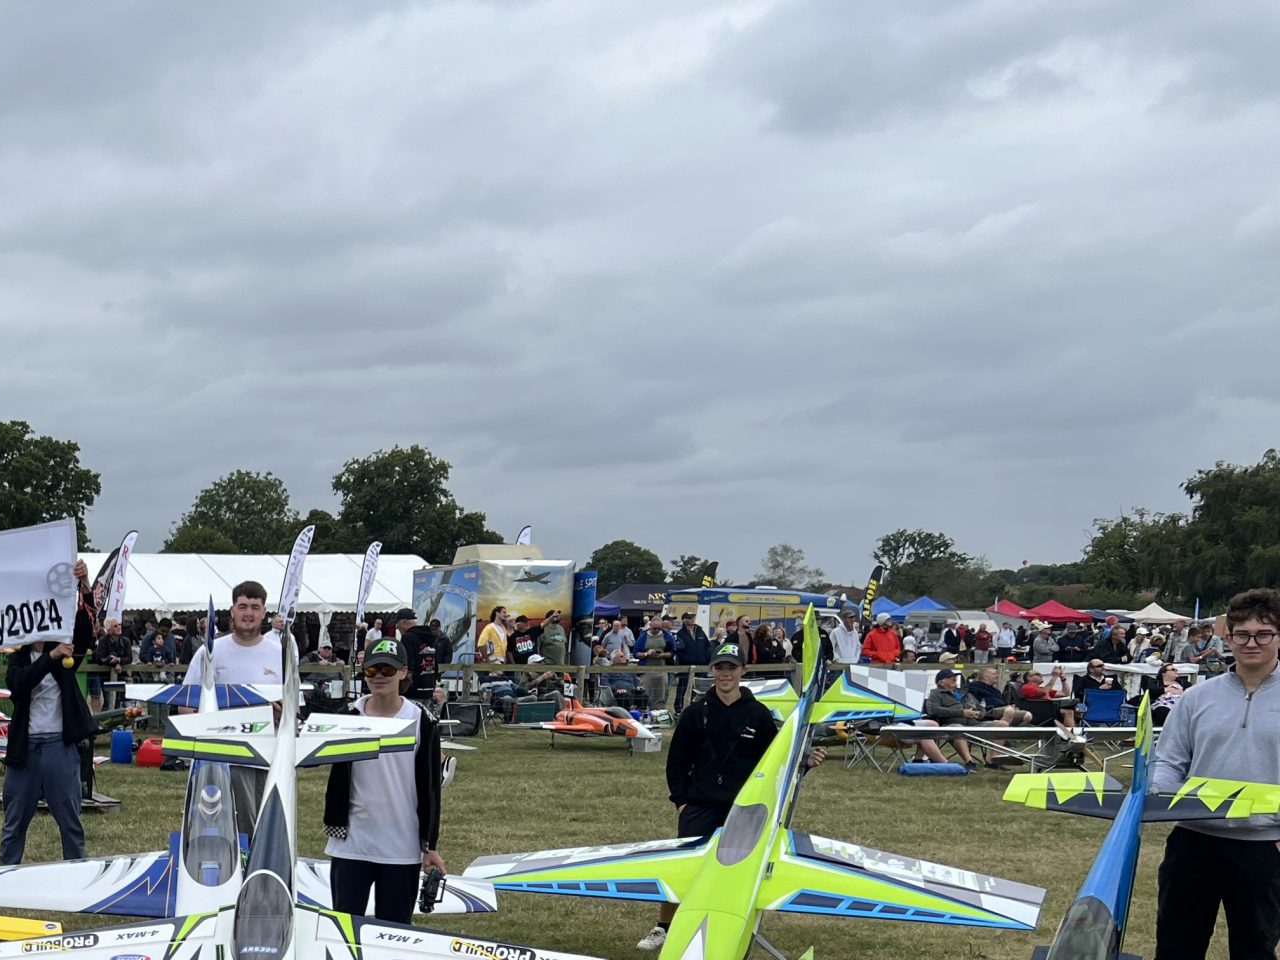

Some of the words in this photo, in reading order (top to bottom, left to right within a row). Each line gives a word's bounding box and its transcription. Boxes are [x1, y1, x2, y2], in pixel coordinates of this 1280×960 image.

[371, 640, 398, 656] AR
[717, 645, 739, 656] AR
[240, 721, 271, 734] AR
[115, 930, 160, 941] 4-MAX
